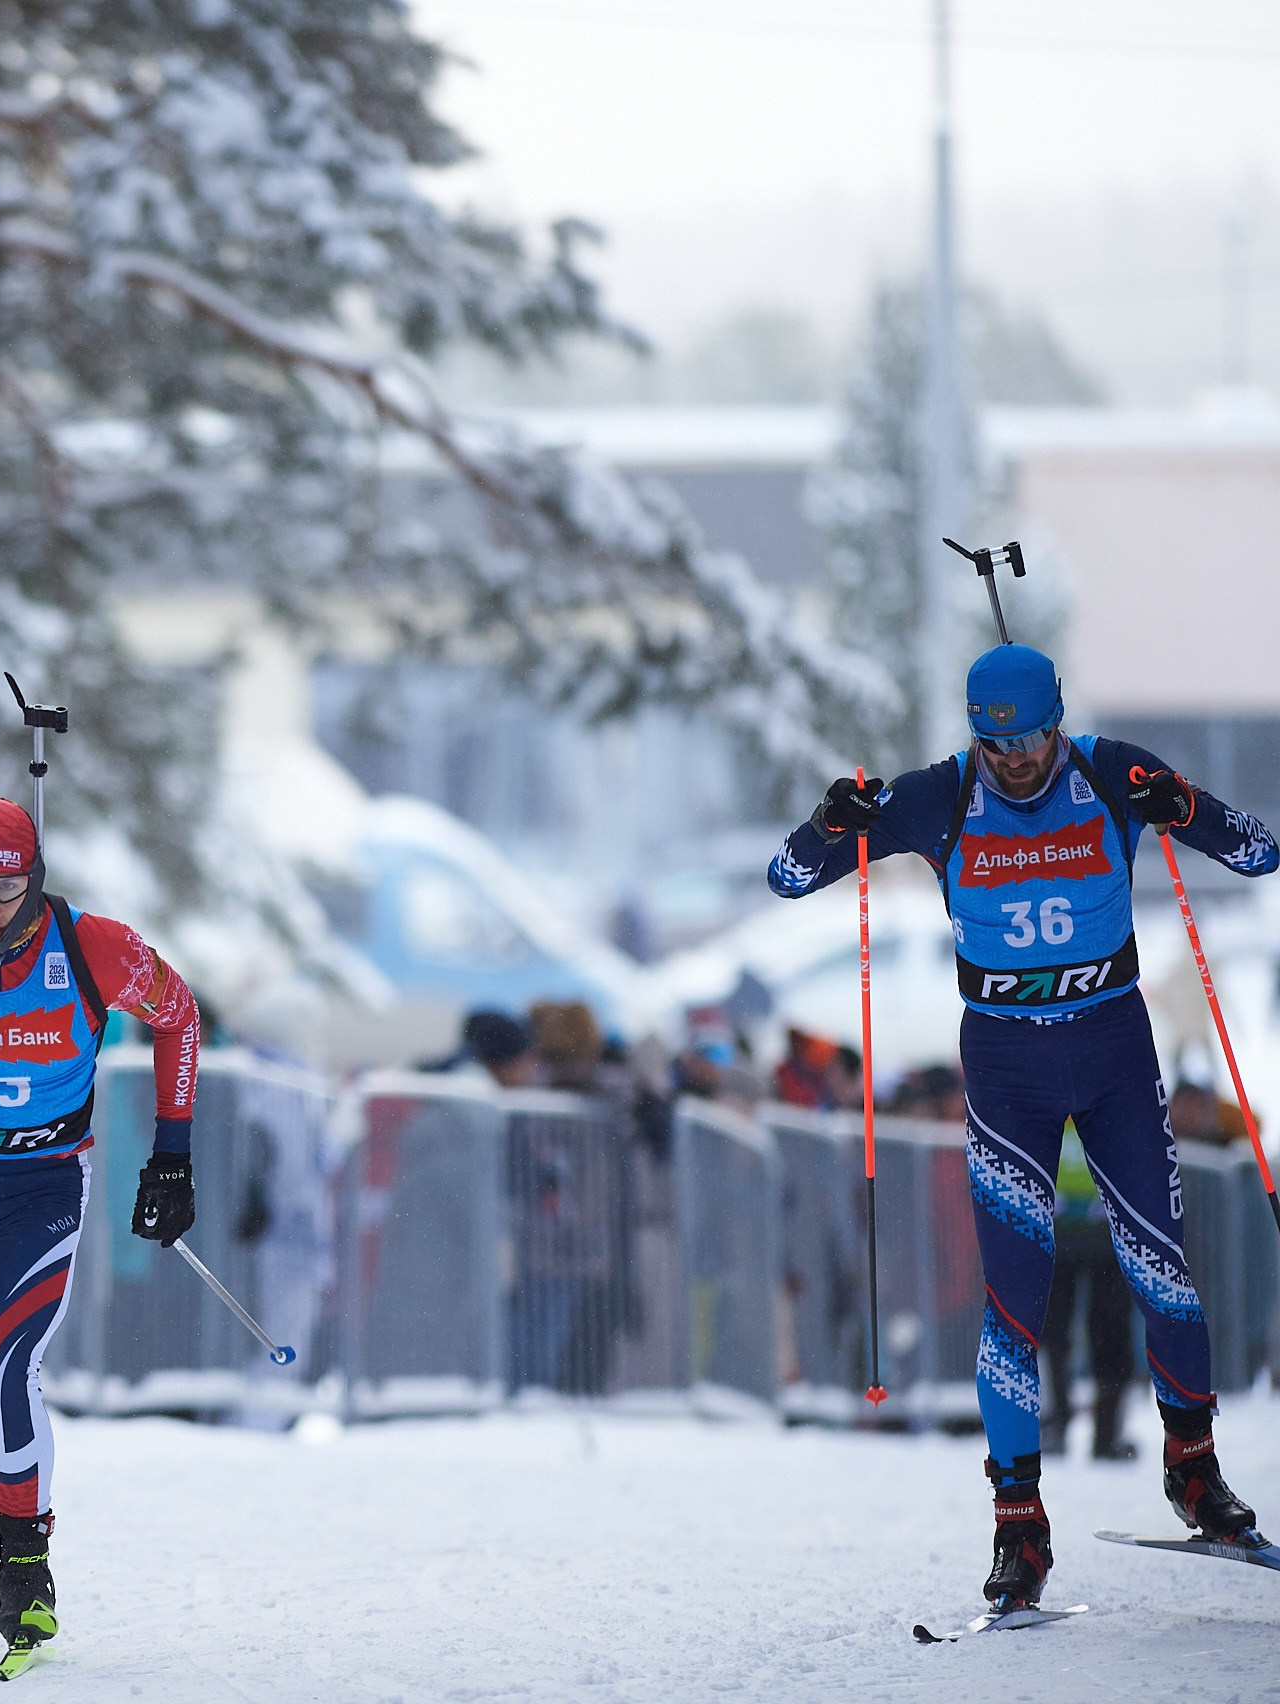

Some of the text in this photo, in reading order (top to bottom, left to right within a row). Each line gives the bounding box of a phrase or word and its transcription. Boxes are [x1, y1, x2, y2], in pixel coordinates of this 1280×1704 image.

[1073, 781, 1090, 791] 2024
[1075, 790, 1093, 800] 2025
[974, 843, 1095, 876] Альфа Банк
[1001, 896, 1075, 949] 36
[49, 964, 65, 975] 2024
[48, 974, 66, 985] 2025
[981, 960, 1112, 1001] PARI
[8, 1028, 63, 1046] Банк
[174, 1020, 195, 1106] #КОМАНДА
[158, 1172, 185, 1180] MOAX
[47, 1214, 76, 1234] MOAX
[1208, 1544, 1248, 1561] SALOMON
